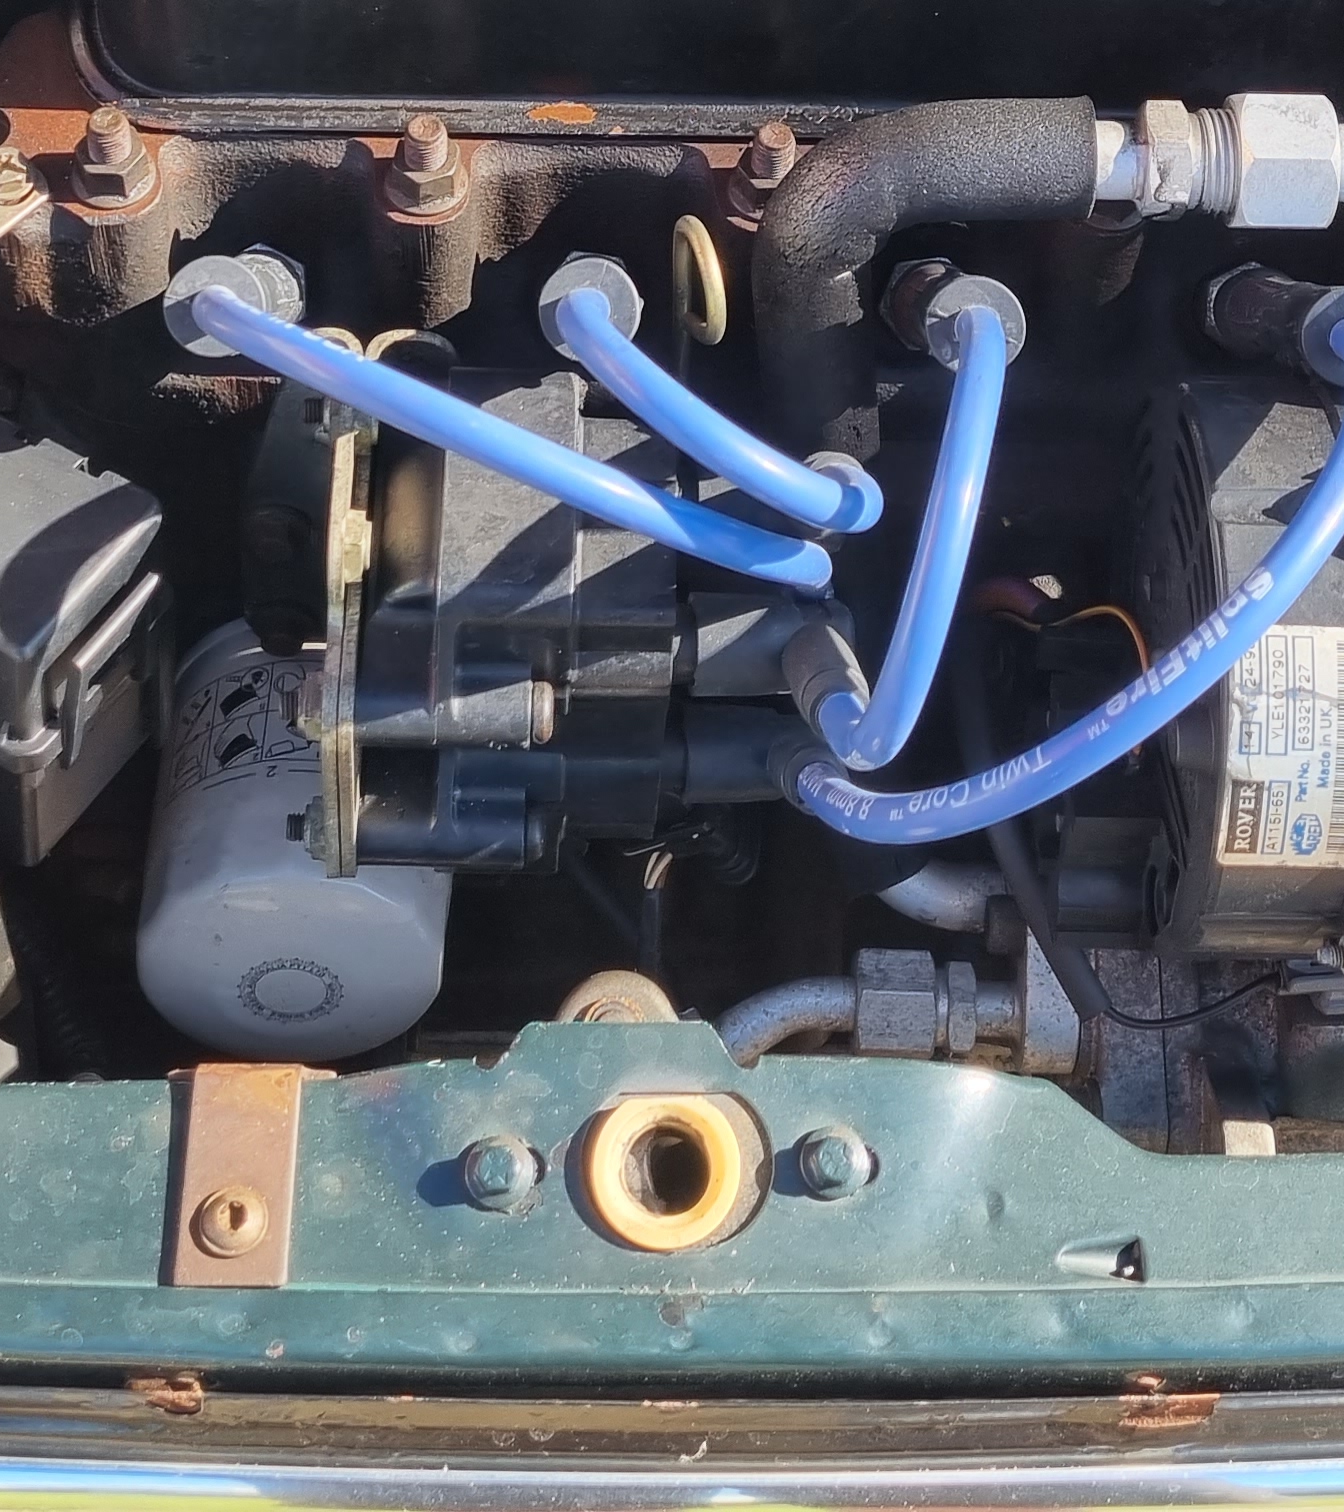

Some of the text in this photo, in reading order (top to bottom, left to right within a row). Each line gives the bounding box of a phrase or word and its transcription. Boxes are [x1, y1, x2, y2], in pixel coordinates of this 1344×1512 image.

[1244, 643, 1257, 688] 24-9
[1272, 649, 1285, 740] YLE101790
[981, 745, 1053, 793] Twin
[1297, 759, 1310, 782] No.
[1316, 707, 1333, 789] Made in UK
[1294, 782, 1308, 803] Part
[1233, 784, 1258, 852] ROVER
